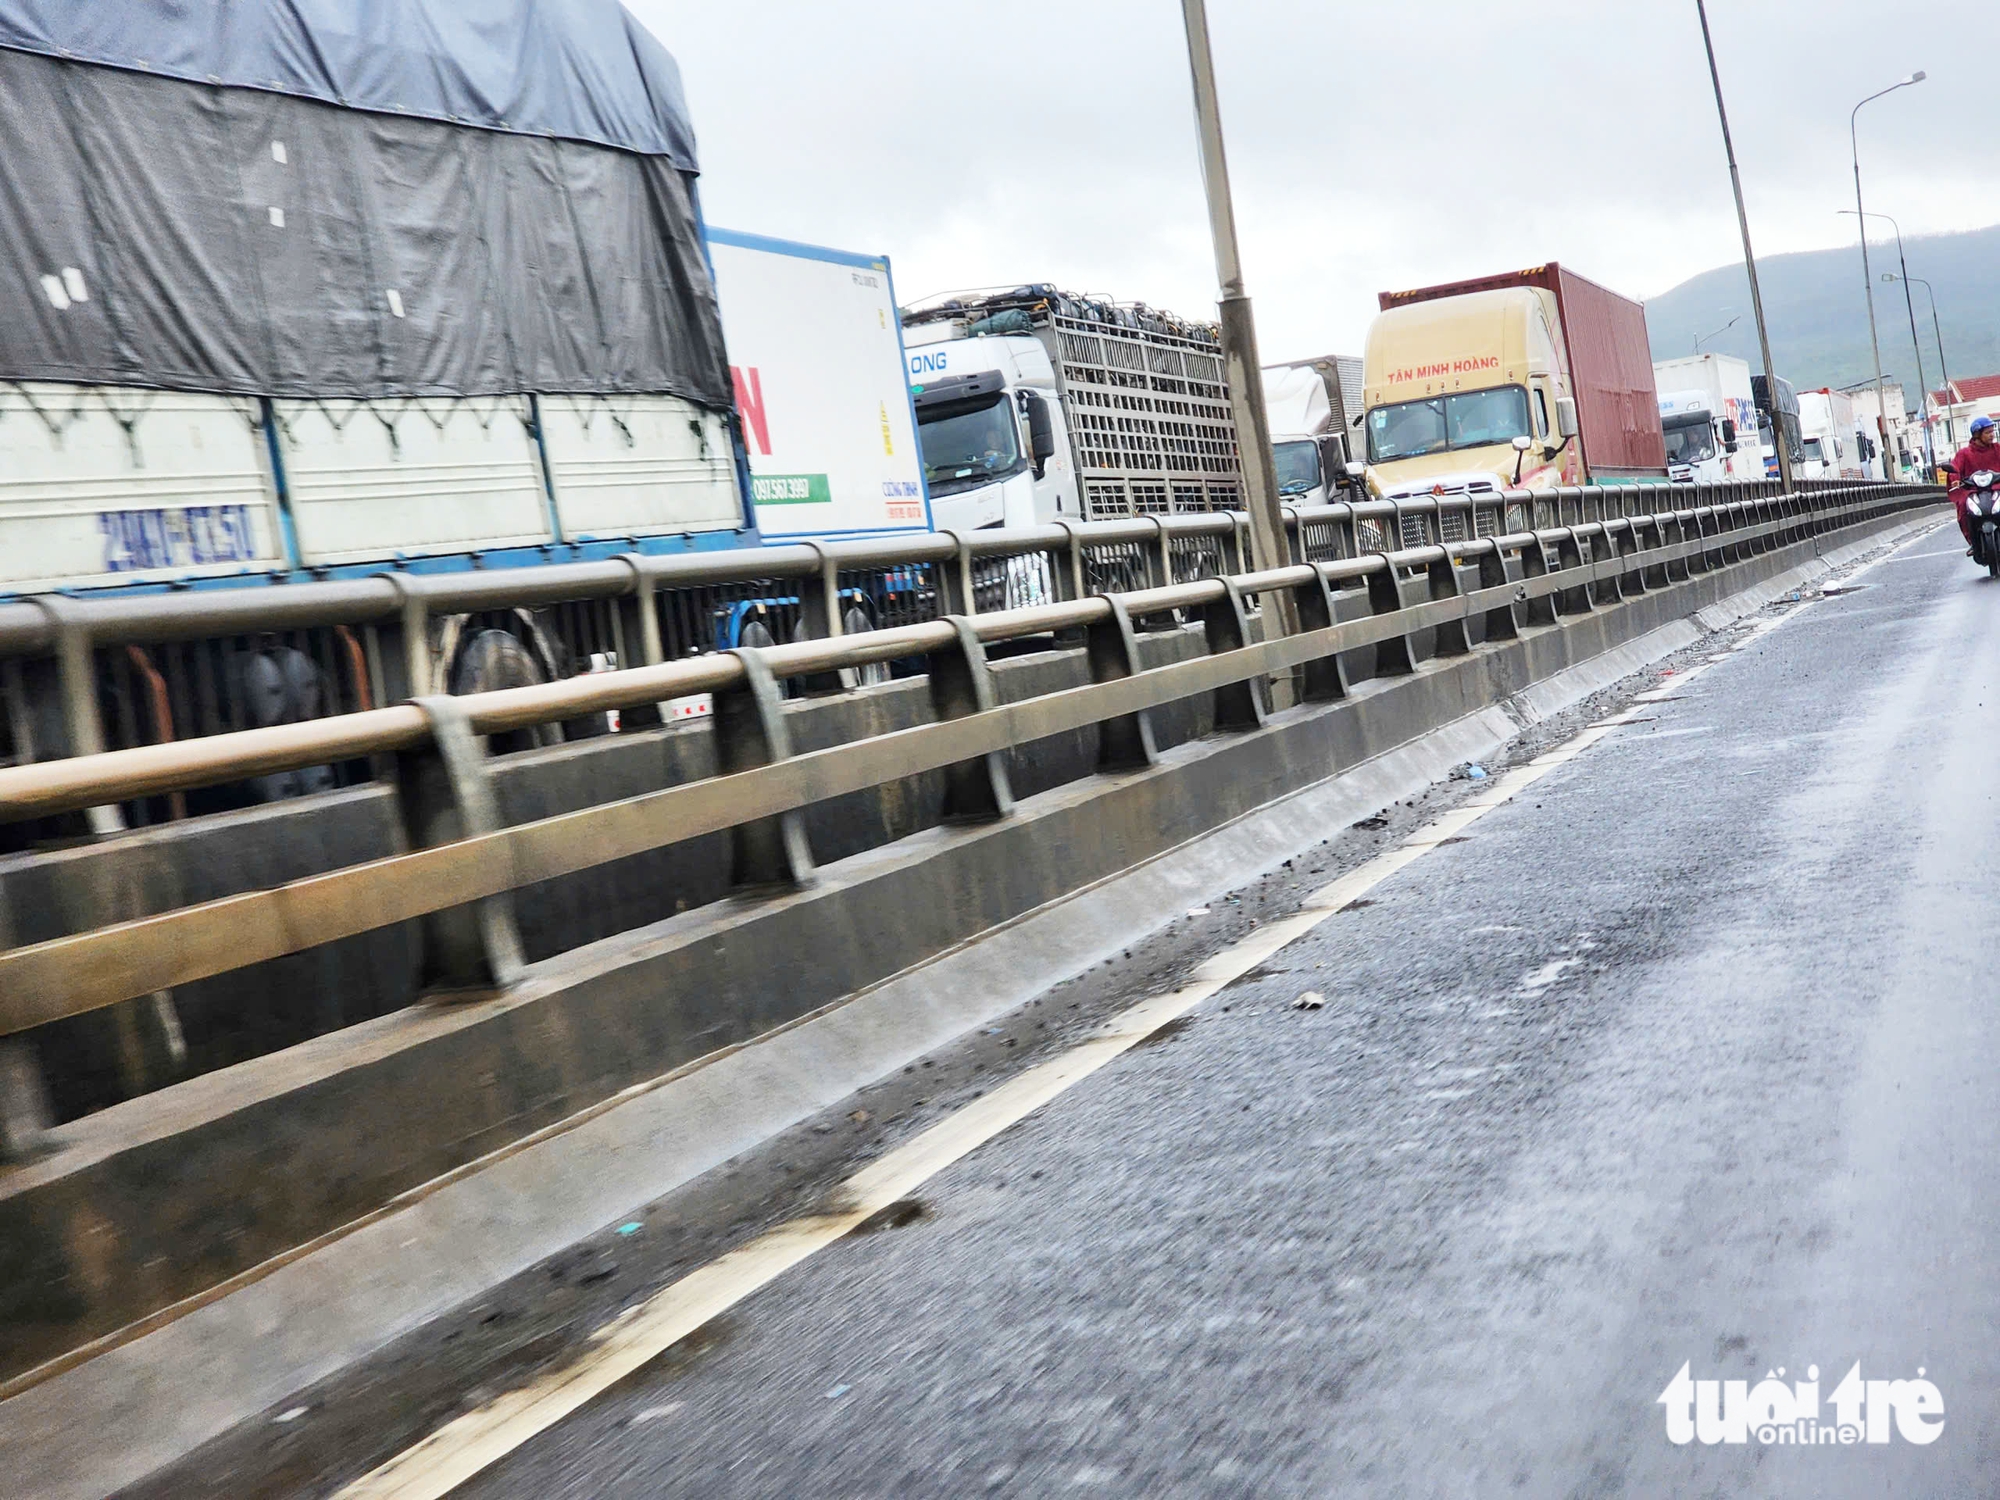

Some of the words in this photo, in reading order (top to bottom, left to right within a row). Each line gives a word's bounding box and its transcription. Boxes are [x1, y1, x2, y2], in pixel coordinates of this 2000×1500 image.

[1387, 368, 1414, 385] TÂN
[1417, 362, 1450, 379] MINH
[1453, 356, 1500, 374] HOÀNG
